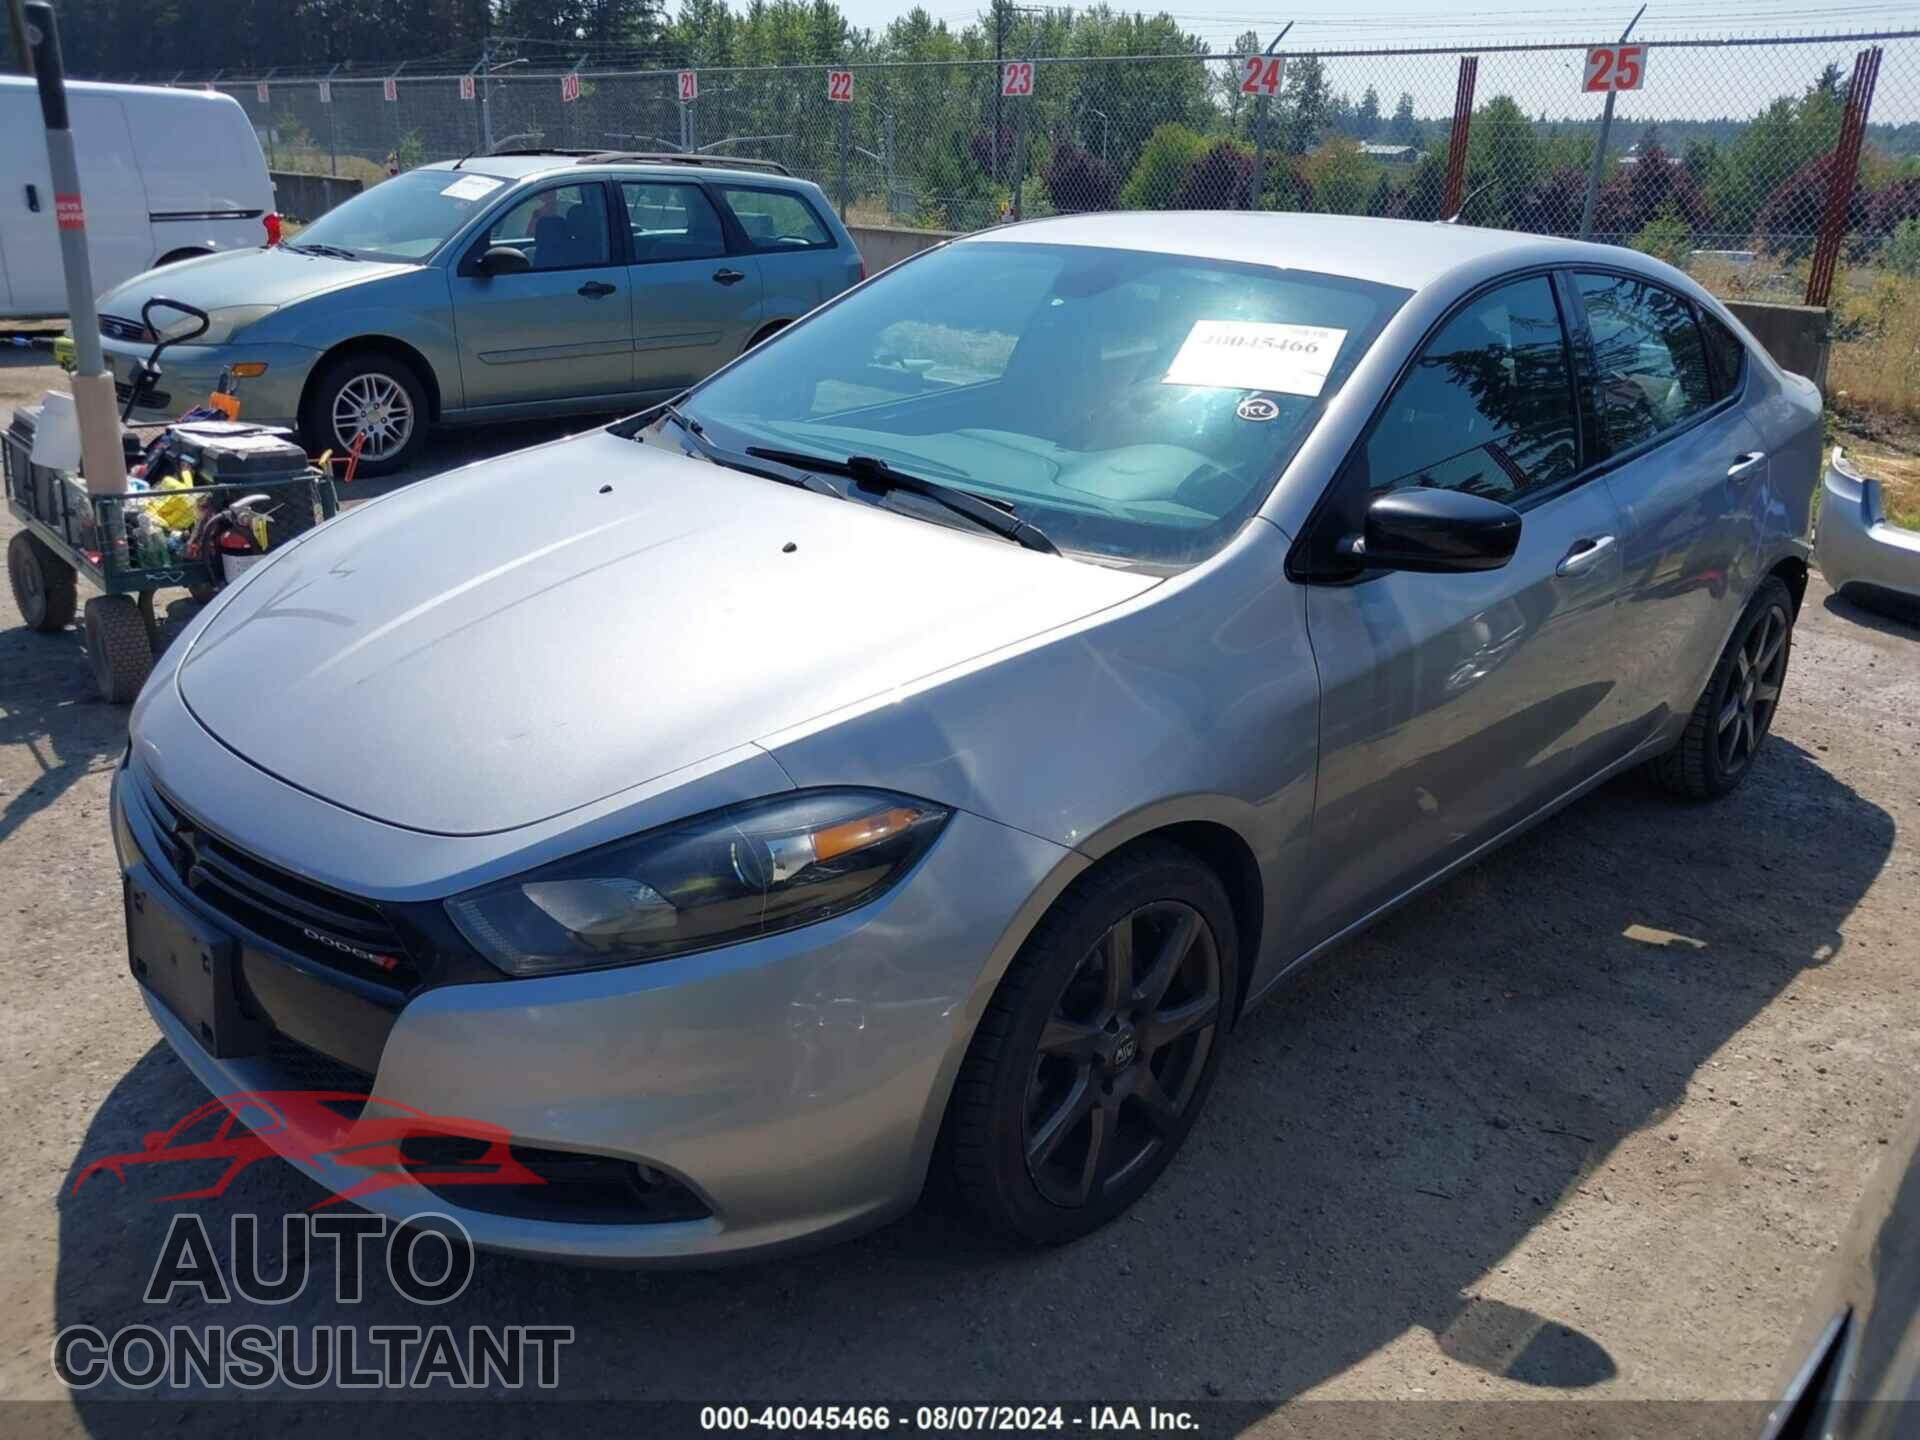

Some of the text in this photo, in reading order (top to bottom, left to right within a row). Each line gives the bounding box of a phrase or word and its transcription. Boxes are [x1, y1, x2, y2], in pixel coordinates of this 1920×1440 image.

[1005, 64, 1031, 94] 23
[1242, 56, 1280, 94] 24
[1586, 47, 1641, 92] 25
[564, 76, 578, 99] 20
[682, 74, 695, 98] 21
[830, 73, 851, 100] 22
